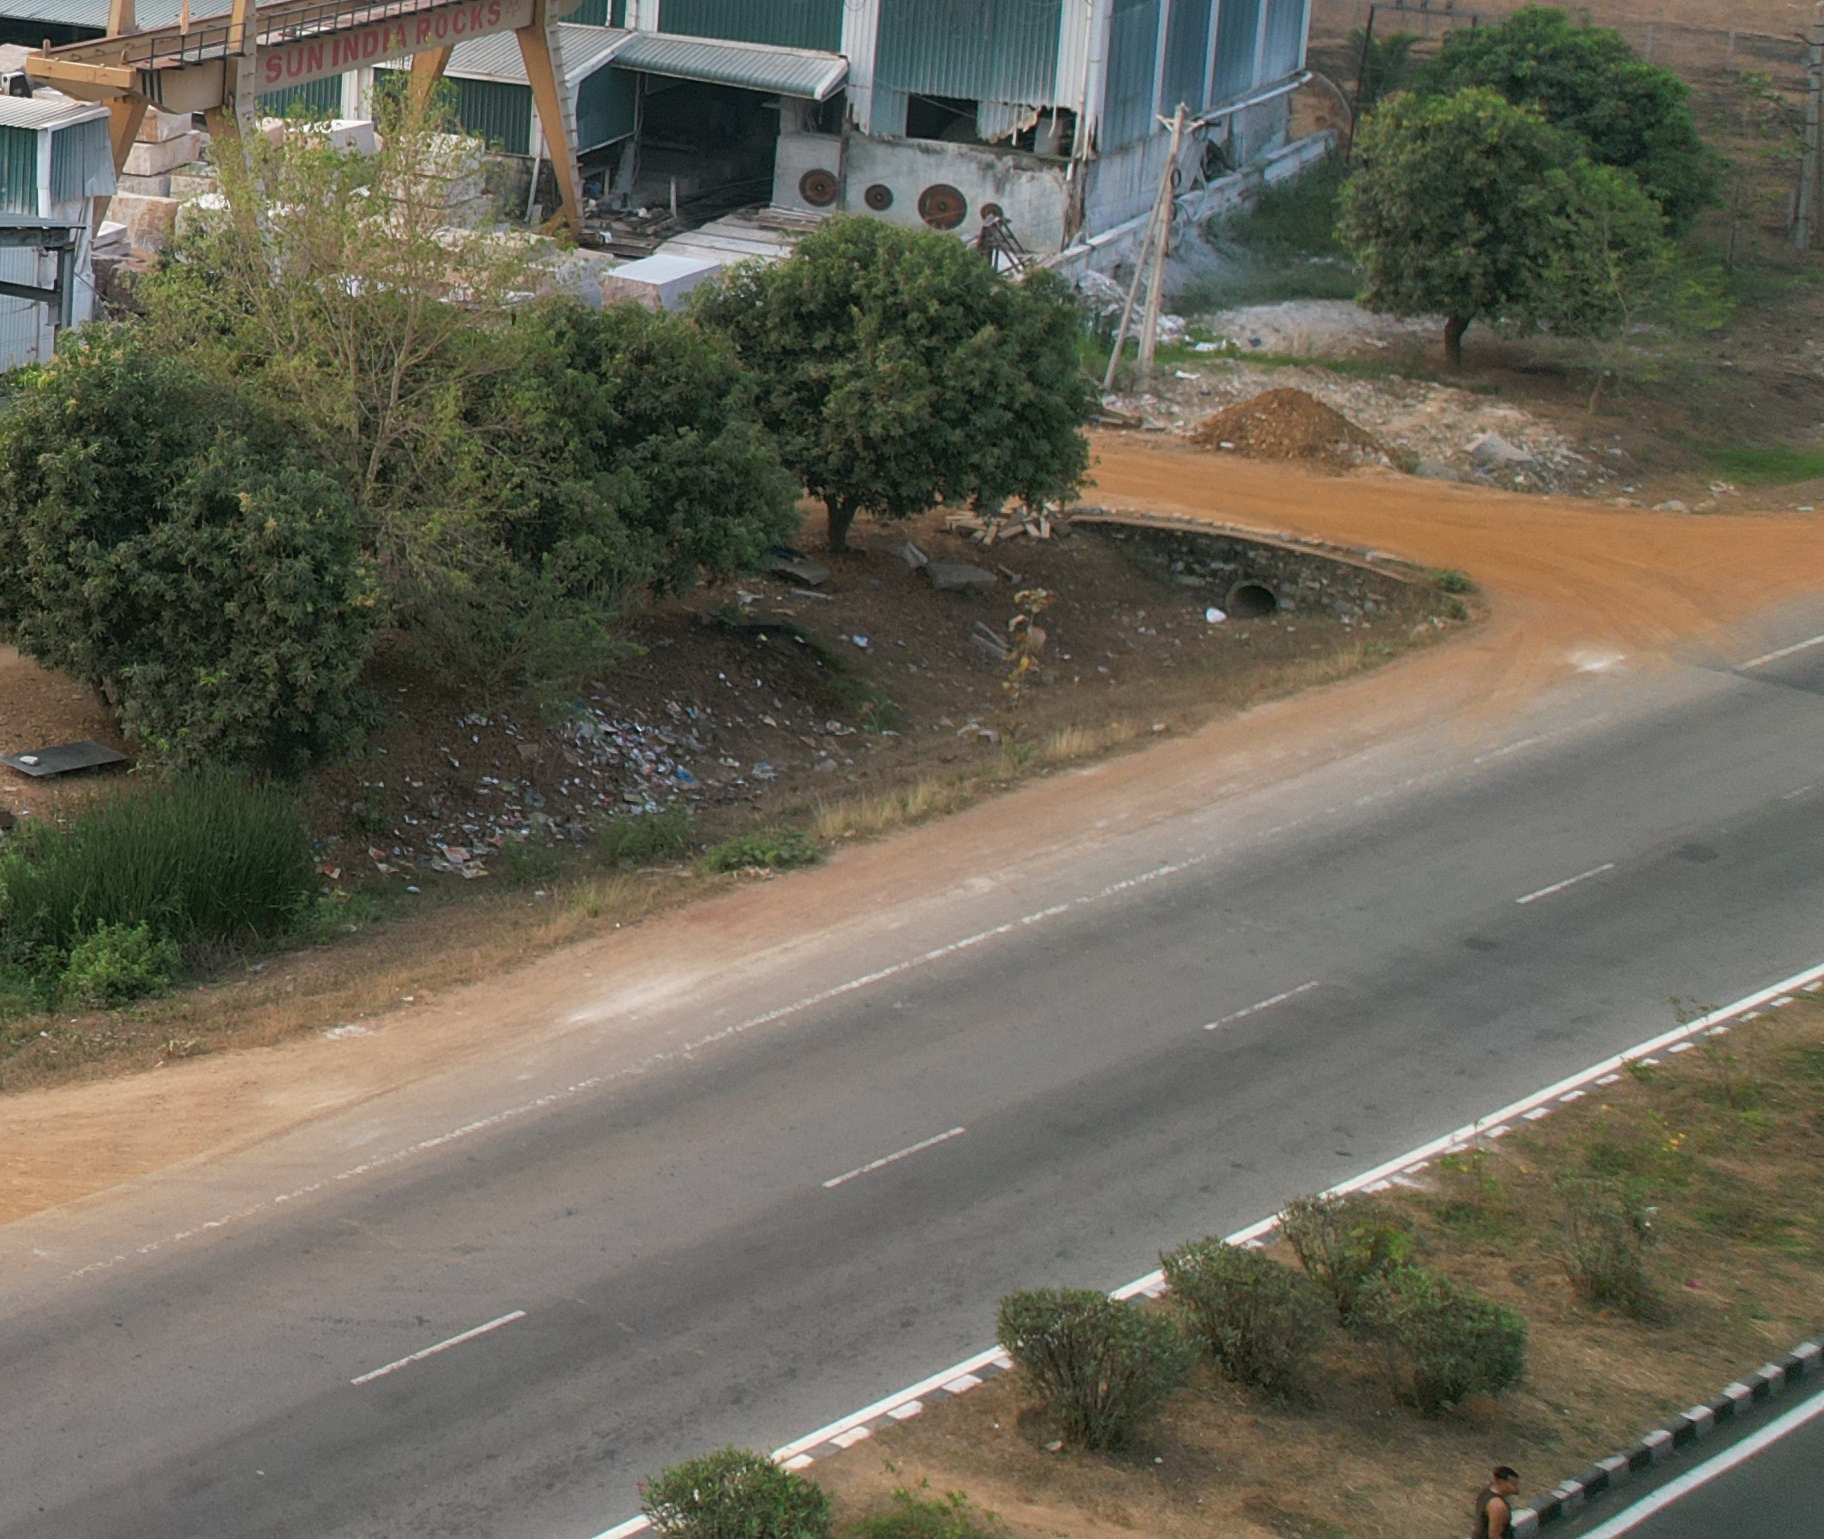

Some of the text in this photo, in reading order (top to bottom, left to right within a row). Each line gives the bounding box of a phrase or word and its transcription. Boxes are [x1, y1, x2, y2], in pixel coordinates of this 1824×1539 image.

[265, 0, 501, 84] SUN INDIA ROCKS
